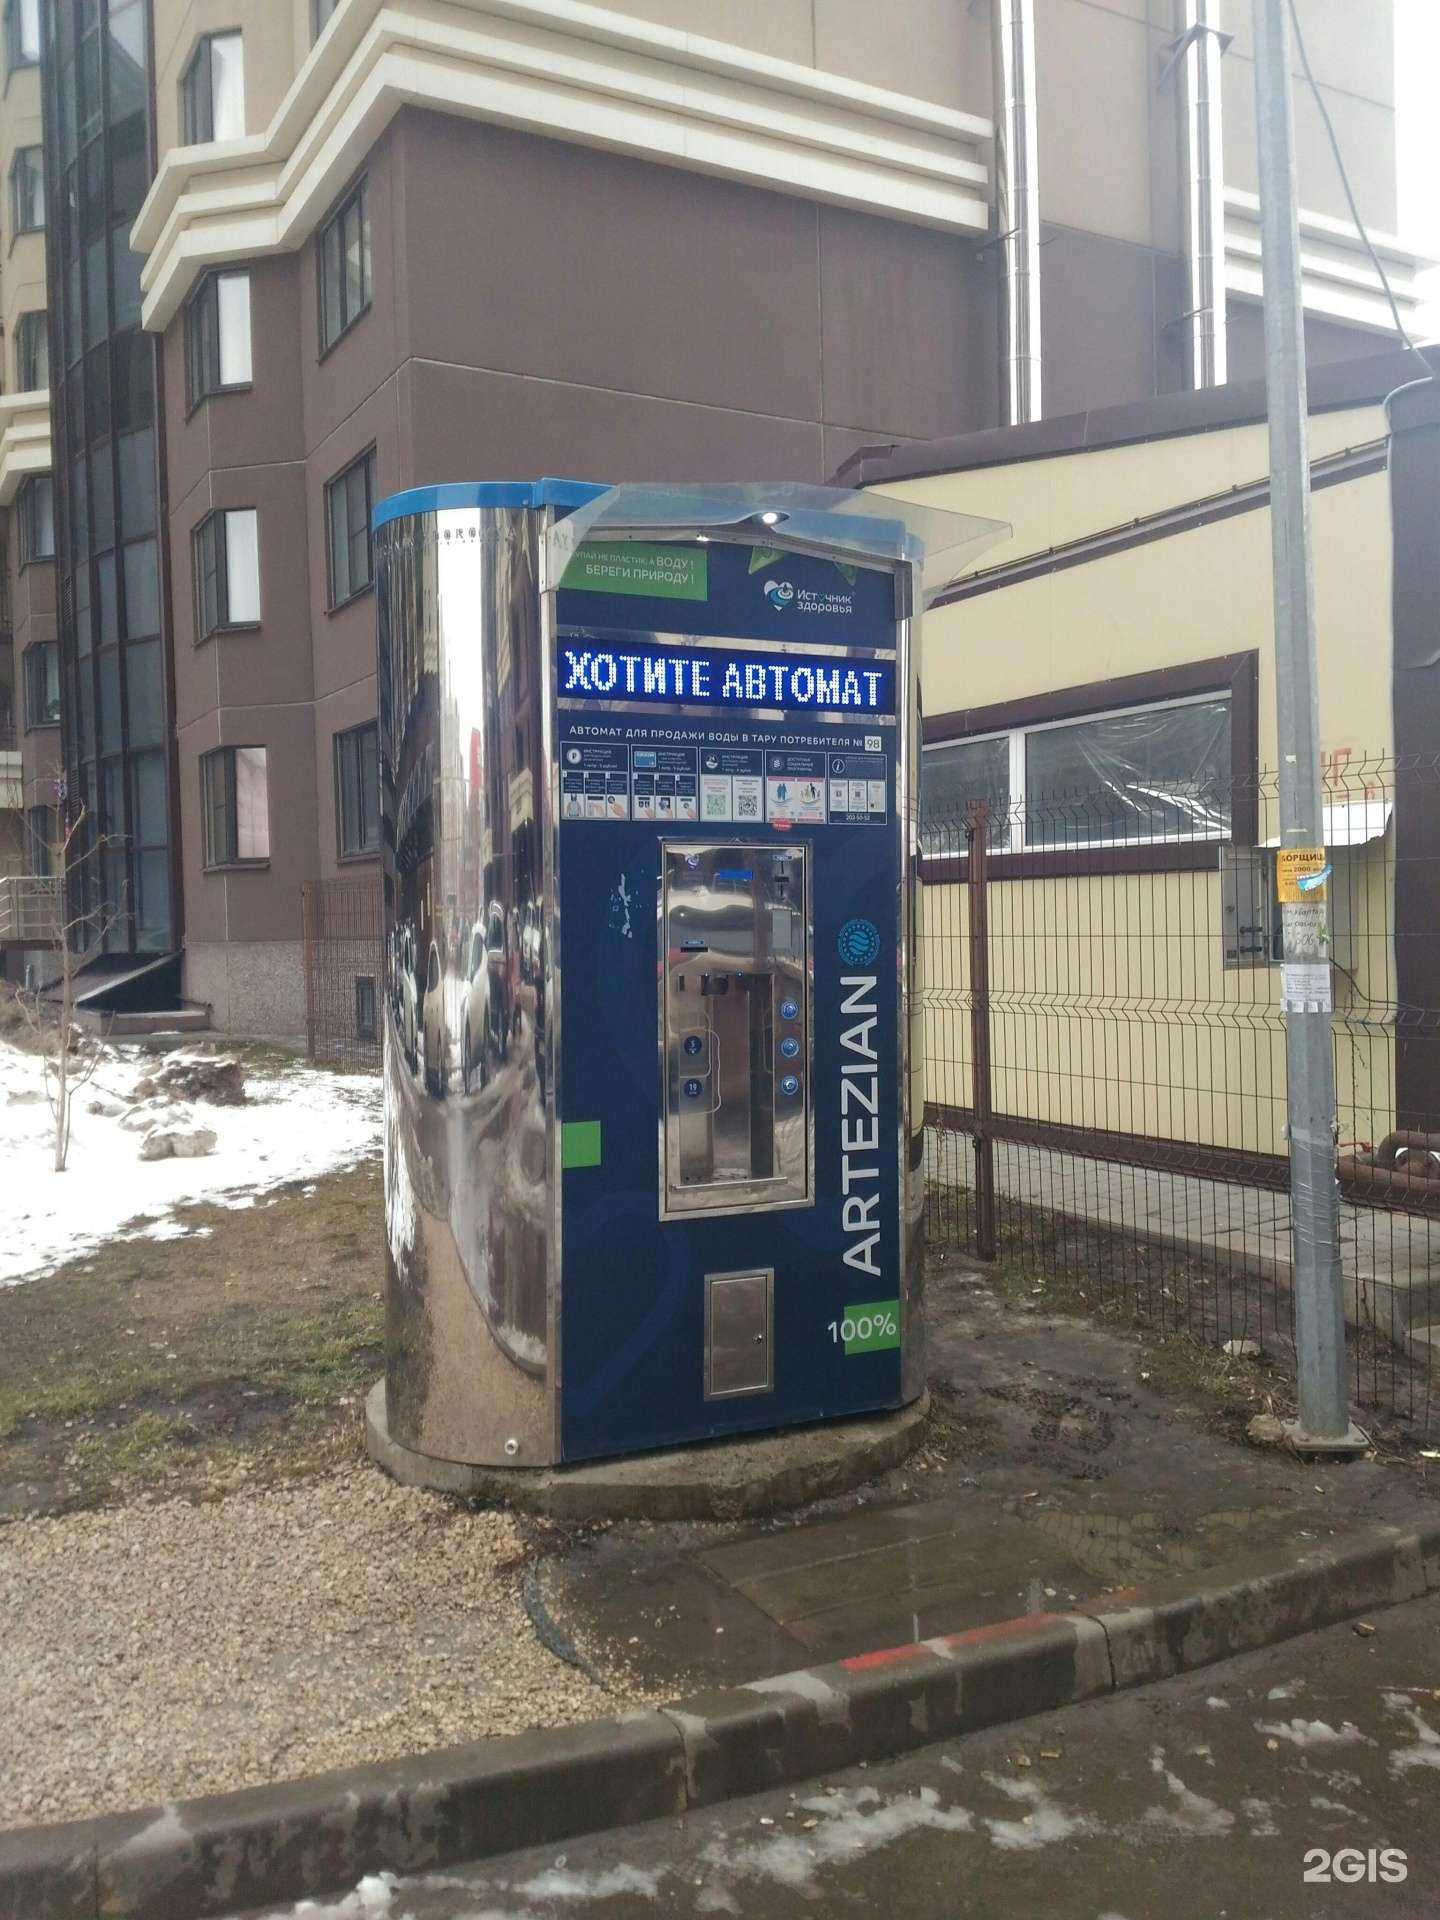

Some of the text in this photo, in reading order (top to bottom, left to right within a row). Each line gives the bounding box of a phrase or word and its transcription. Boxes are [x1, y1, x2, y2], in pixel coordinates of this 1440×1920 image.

[585, 564, 631, 579] БЕРЕГИ
[565, 650, 883, 706] ХОТИТЕ АВТОМАТ
[569, 725, 622, 737] АВТОМАТ
[625, 728, 648, 738] ДЛЯ
[650, 729, 705, 741] ПРОДАЖИ
[708, 732, 740, 743] ВОДЫ
[742, 734, 749, 742] В
[751, 734, 777, 744] ТАРУ
[780, 735, 850, 747] ПОТРЕБИТЕЛЯ
[866, 739, 880, 749] 98
[840, 975, 881, 1277] ARTEZIAN
[827, 1312, 897, 1344] 100%
